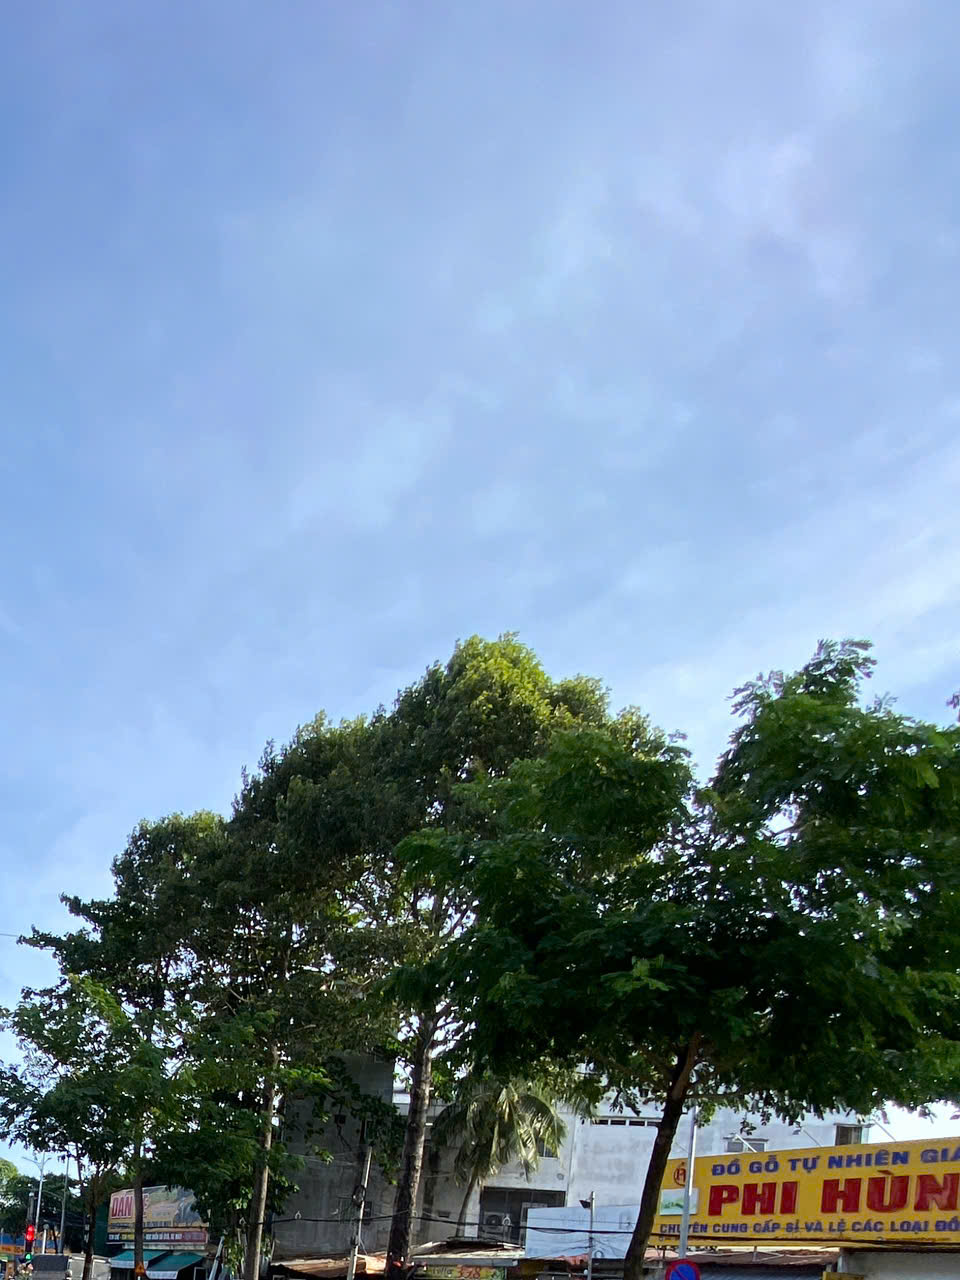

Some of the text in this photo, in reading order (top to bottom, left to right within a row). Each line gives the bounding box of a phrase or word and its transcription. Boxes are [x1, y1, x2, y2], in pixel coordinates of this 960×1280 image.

[711, 1156, 741, 1176] ĐỒ
[749, 1154, 779, 1173] GỖ
[787, 1154, 820, 1173] TỰ
[827, 1149, 909, 1169] NHIÊN
[708, 1170, 960, 1216] PHI HÙN
[712, 1223, 748, 1234] CUNG
[753, 1219, 780, 1233] CẤP
[804, 1220, 823, 1233] VÀ
[851, 1218, 885, 1233] CÁC
[890, 1220, 929, 1235] LOẠI
